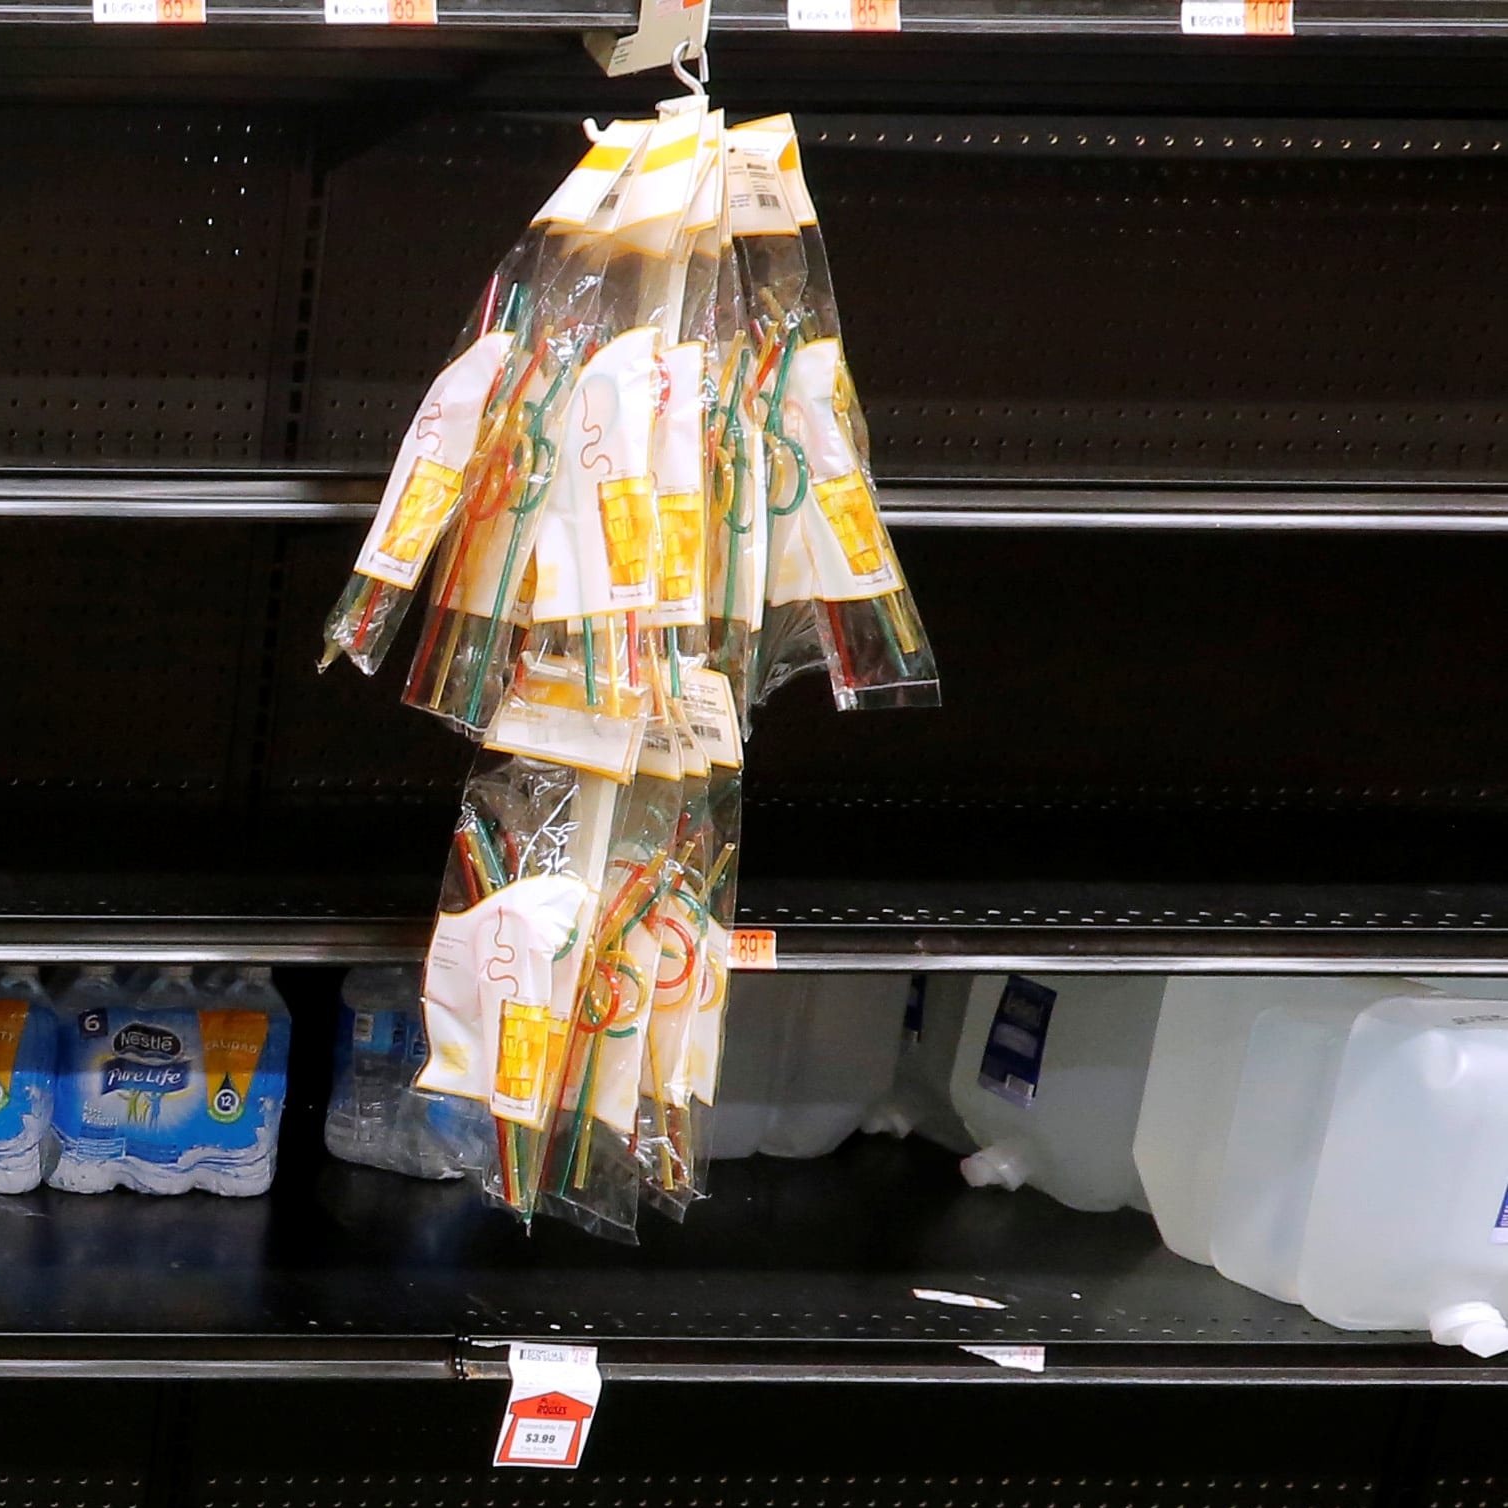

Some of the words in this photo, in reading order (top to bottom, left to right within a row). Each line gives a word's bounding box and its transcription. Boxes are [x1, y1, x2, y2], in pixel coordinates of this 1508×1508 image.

[84, 1014, 100, 1031] 6
[146, 1067, 182, 1085] Life
[220, 1095, 232, 1107] 12
[524, 1433, 556, 1444] $3.99
